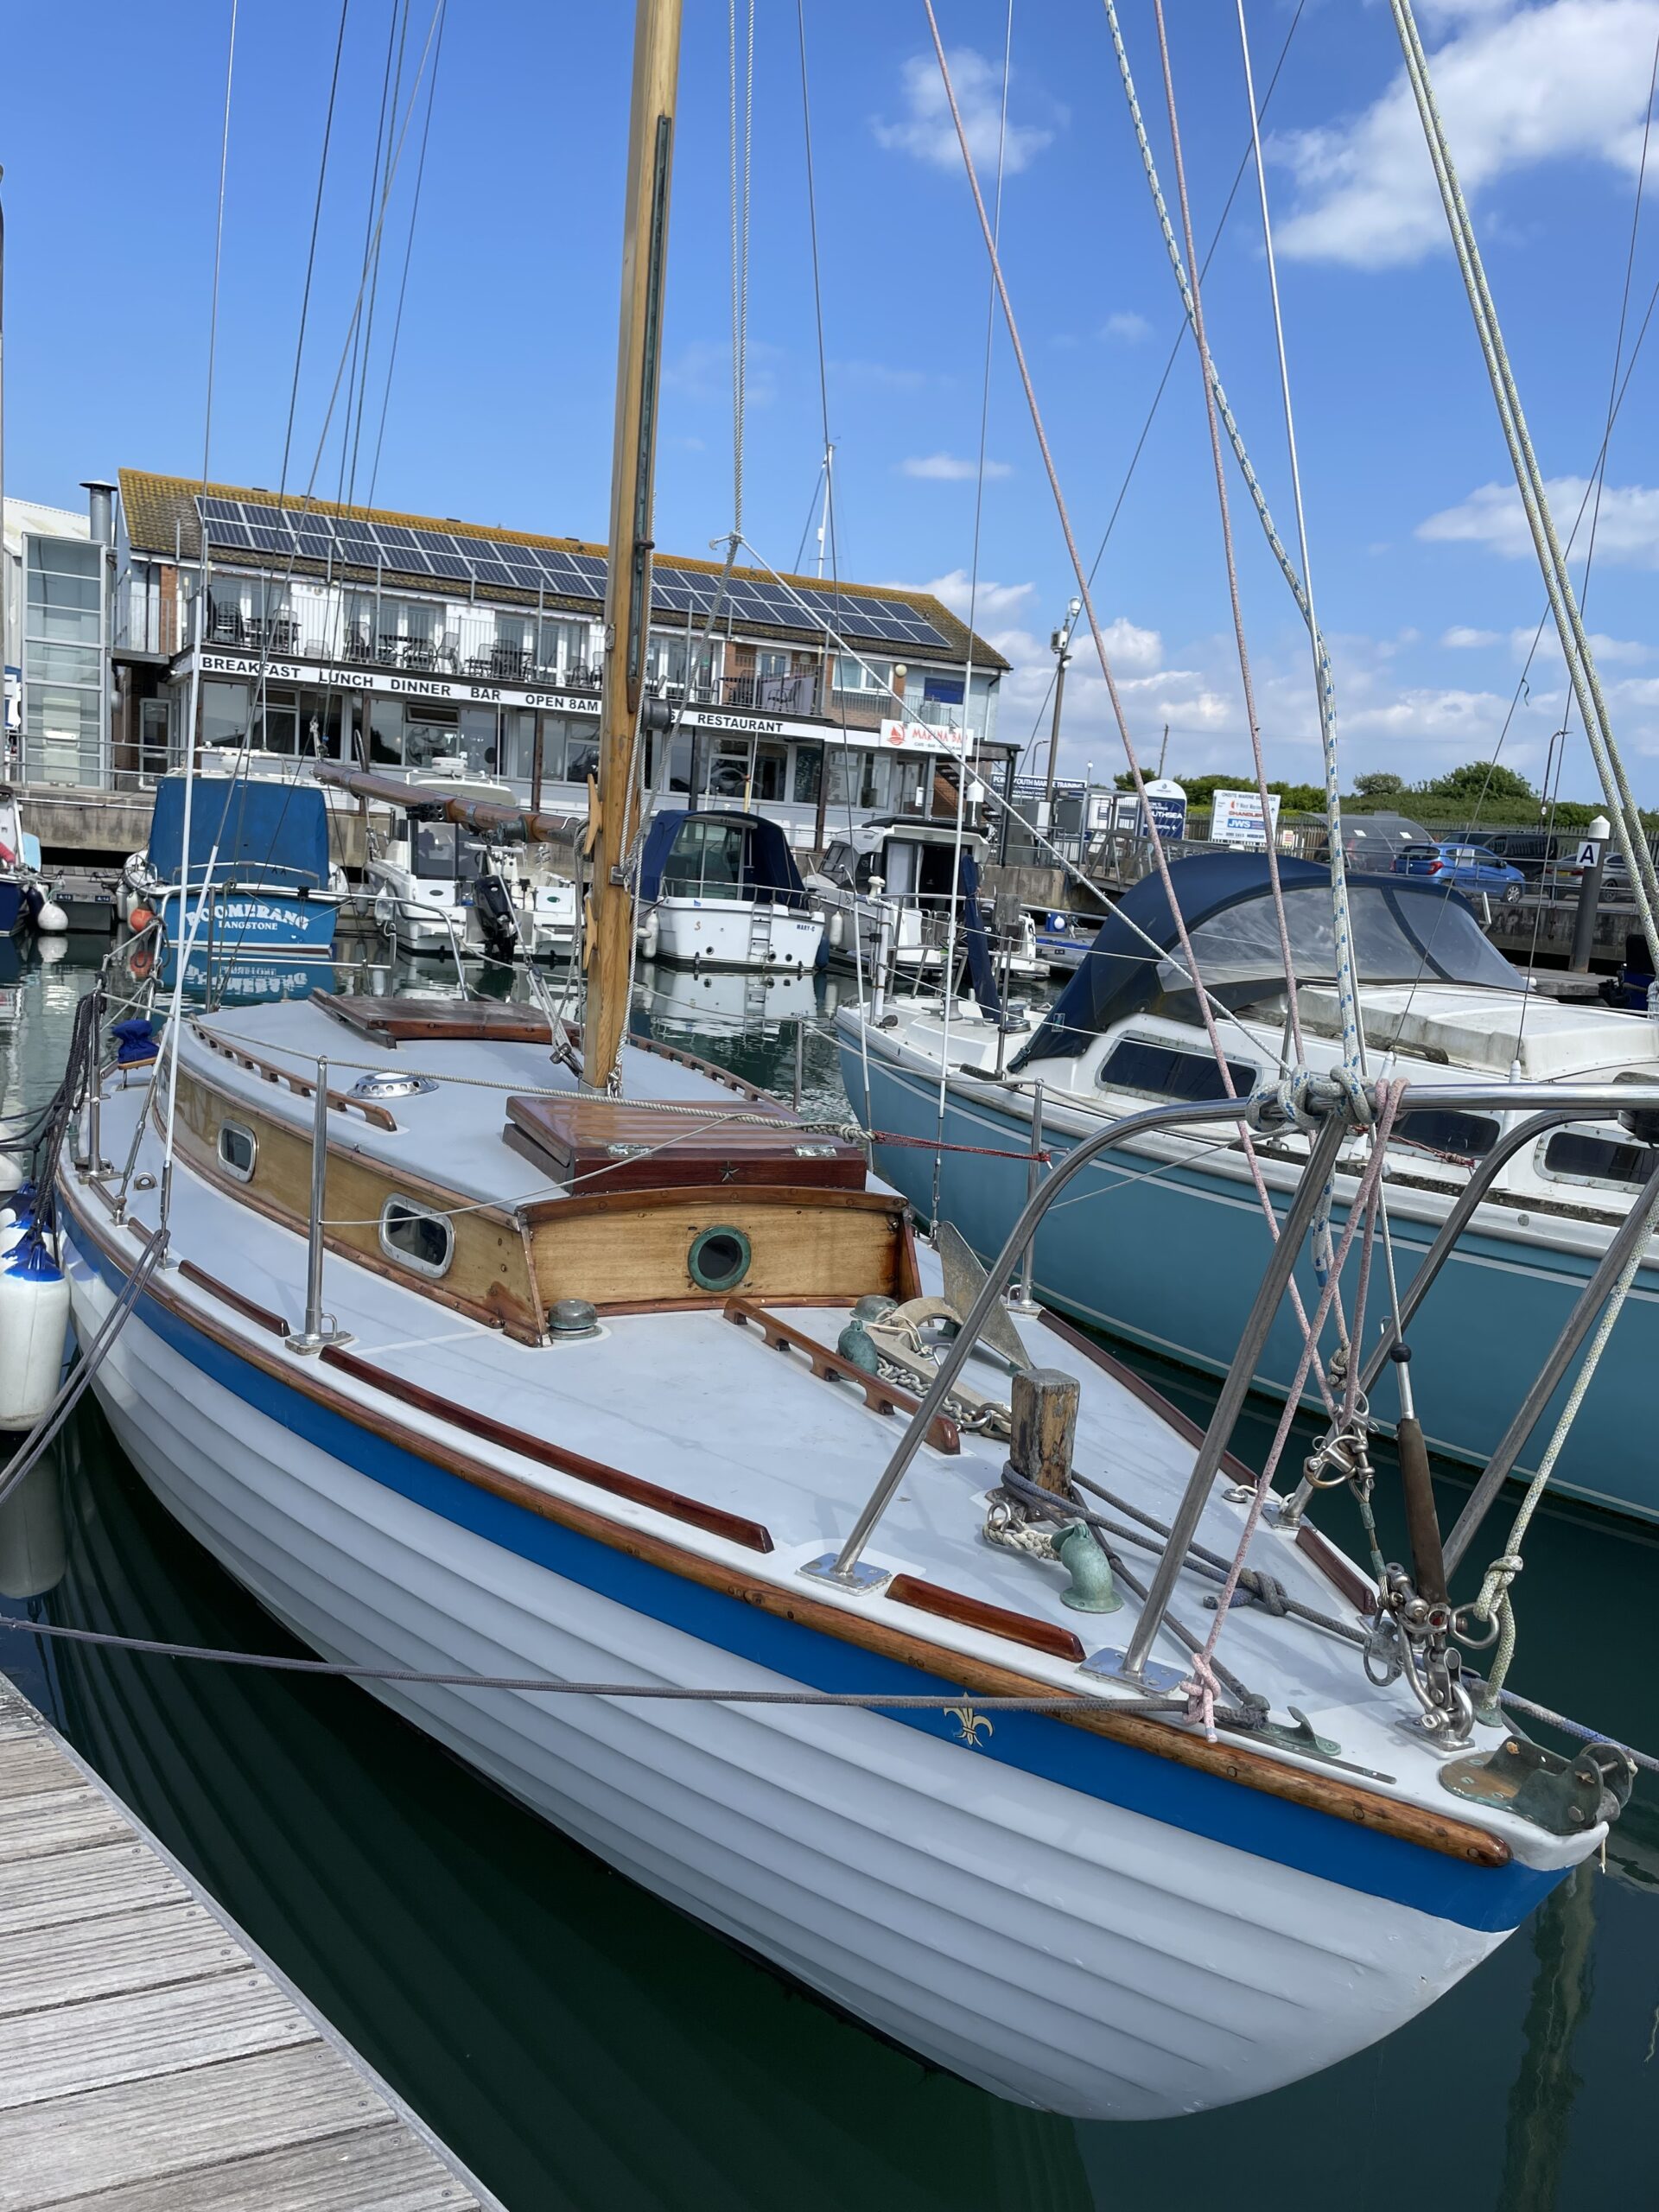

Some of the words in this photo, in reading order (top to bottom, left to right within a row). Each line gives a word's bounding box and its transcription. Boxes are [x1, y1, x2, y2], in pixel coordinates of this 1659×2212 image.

[202, 657, 301, 679] BREAKFAST
[319, 671, 373, 688] LUNCH
[391, 679, 451, 696] DINNER
[470, 687, 500, 701] BAR
[525, 694, 563, 709] OPEN
[569, 698, 598, 712] 8AM
[697, 714, 784, 733] RESTAURANT
[1229, 820, 1251, 829] JWS
[1580, 844, 1594, 864] A
[185, 904, 310, 931] BOOMERANG
[219, 919, 278, 931] LANGSTONE
